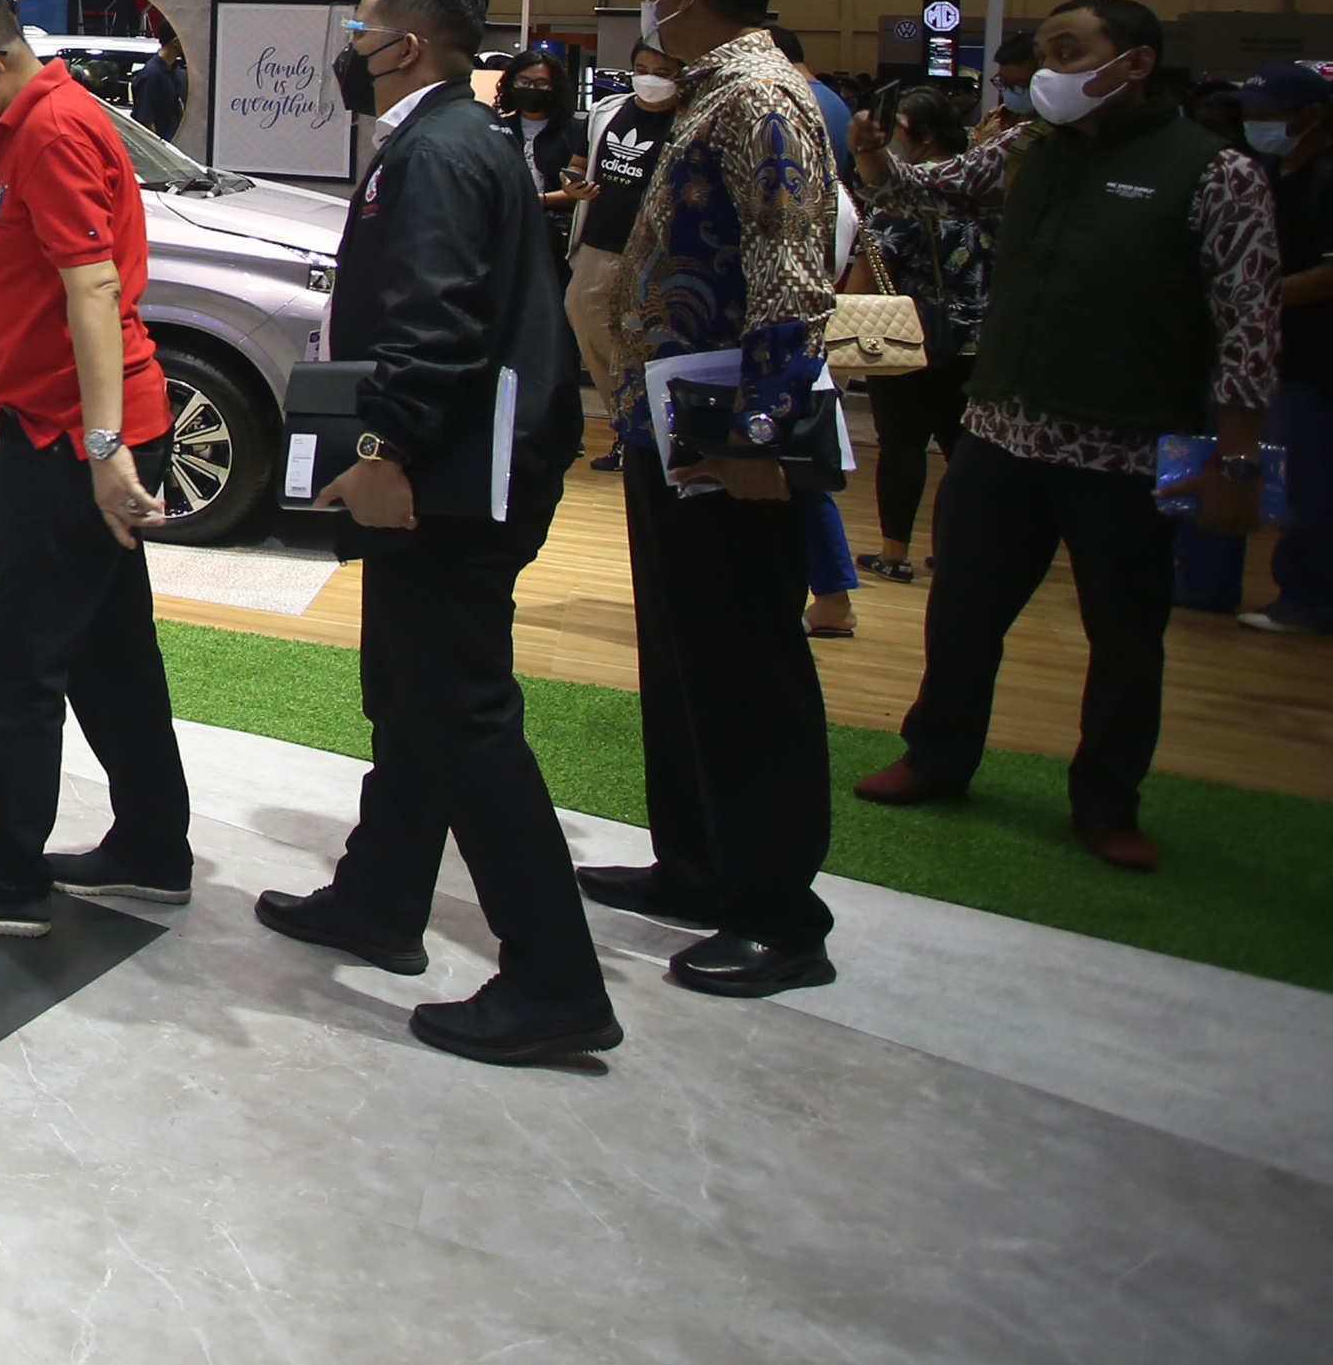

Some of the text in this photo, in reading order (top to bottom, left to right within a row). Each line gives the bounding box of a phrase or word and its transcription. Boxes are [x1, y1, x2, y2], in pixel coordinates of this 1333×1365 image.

[927, 4, 956, 29] MG
[247, 46, 315, 90] family
[273, 79, 288, 95] is
[601, 158, 644, 178] adidas
[602, 173, 631, 185] TOKYO
